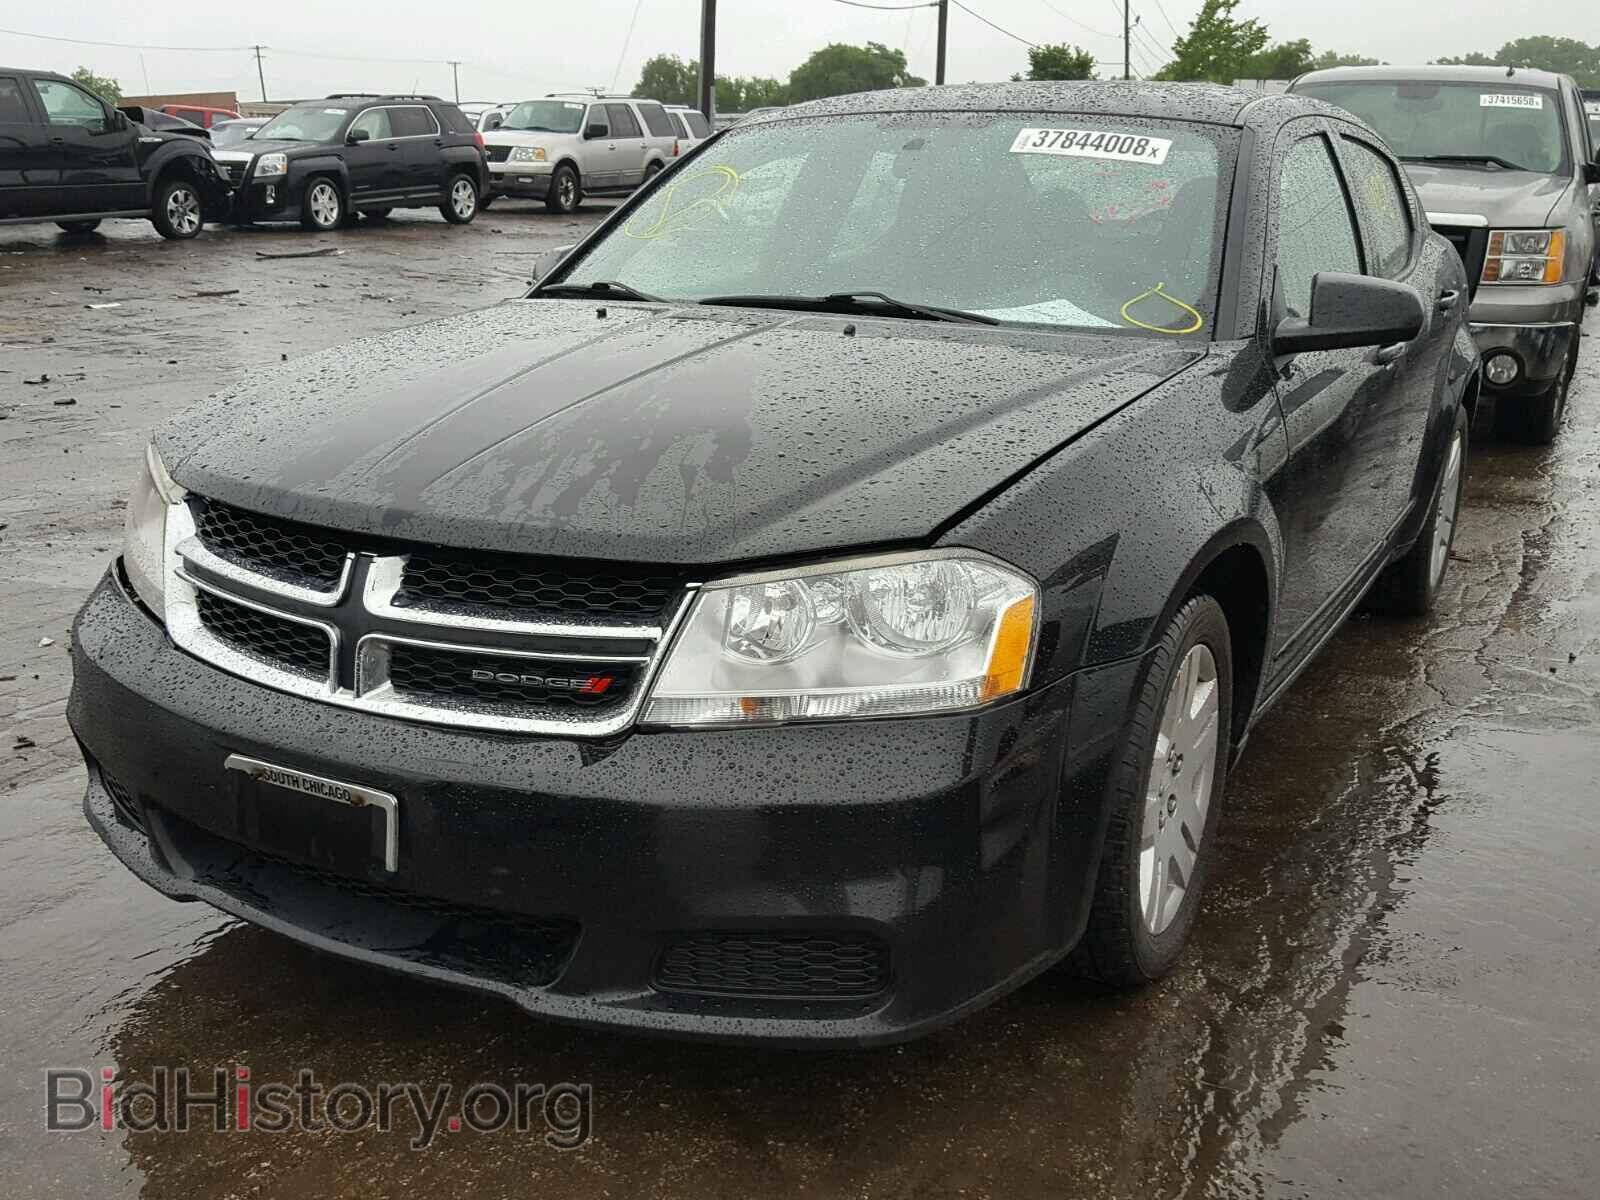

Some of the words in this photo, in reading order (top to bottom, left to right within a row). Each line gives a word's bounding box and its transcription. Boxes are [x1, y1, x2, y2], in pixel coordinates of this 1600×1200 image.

[471, 669, 592, 689] DODGE
[263, 769, 300, 789] SOUTH
[302, 779, 350, 801] CHICAGO
